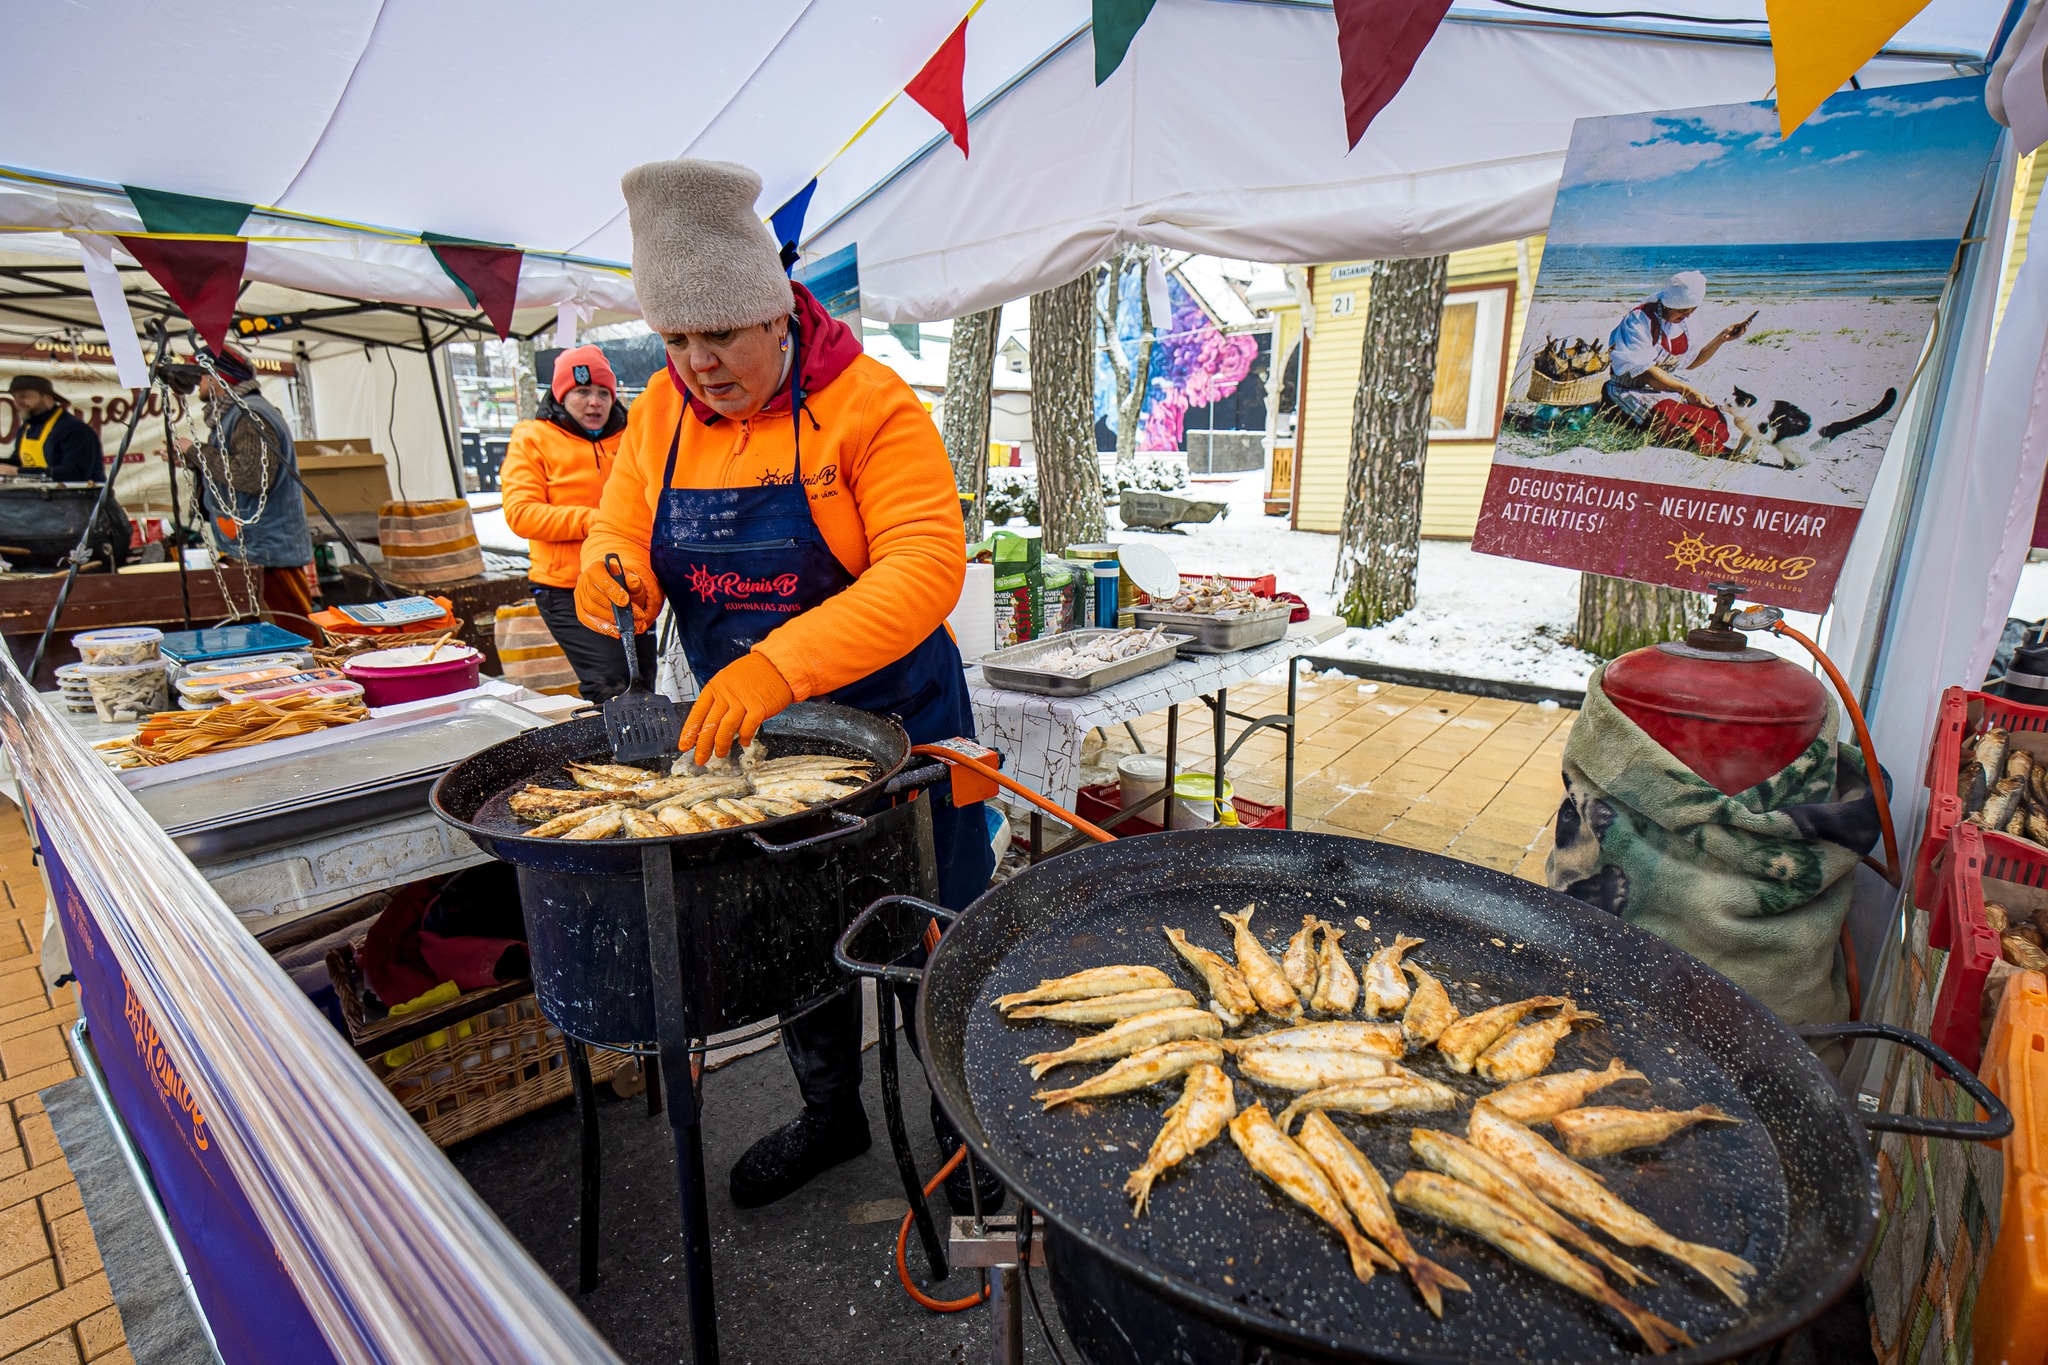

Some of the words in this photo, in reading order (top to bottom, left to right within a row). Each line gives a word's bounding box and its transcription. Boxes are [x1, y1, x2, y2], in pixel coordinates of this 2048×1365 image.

[1335, 297, 1350, 313] 21
[819, 464, 837, 486] B
[1500, 502, 1605, 534] ATTEIKTIES!
[1508, 477, 1638, 512] DEGUSTĀCIJAS
[1659, 496, 1747, 527] NEVIENS
[1752, 508, 1826, 538] NEVAR
[1708, 544, 1778, 574] Reinis
[1778, 556, 1817, 580] B
[717, 572, 773, 599] Reinis
[772, 573, 799, 597] B
[1741, 577, 1762, 586] ZIVIS
[1764, 581, 1775, 589] AR
[777, 603, 801, 612] ZIVIS
